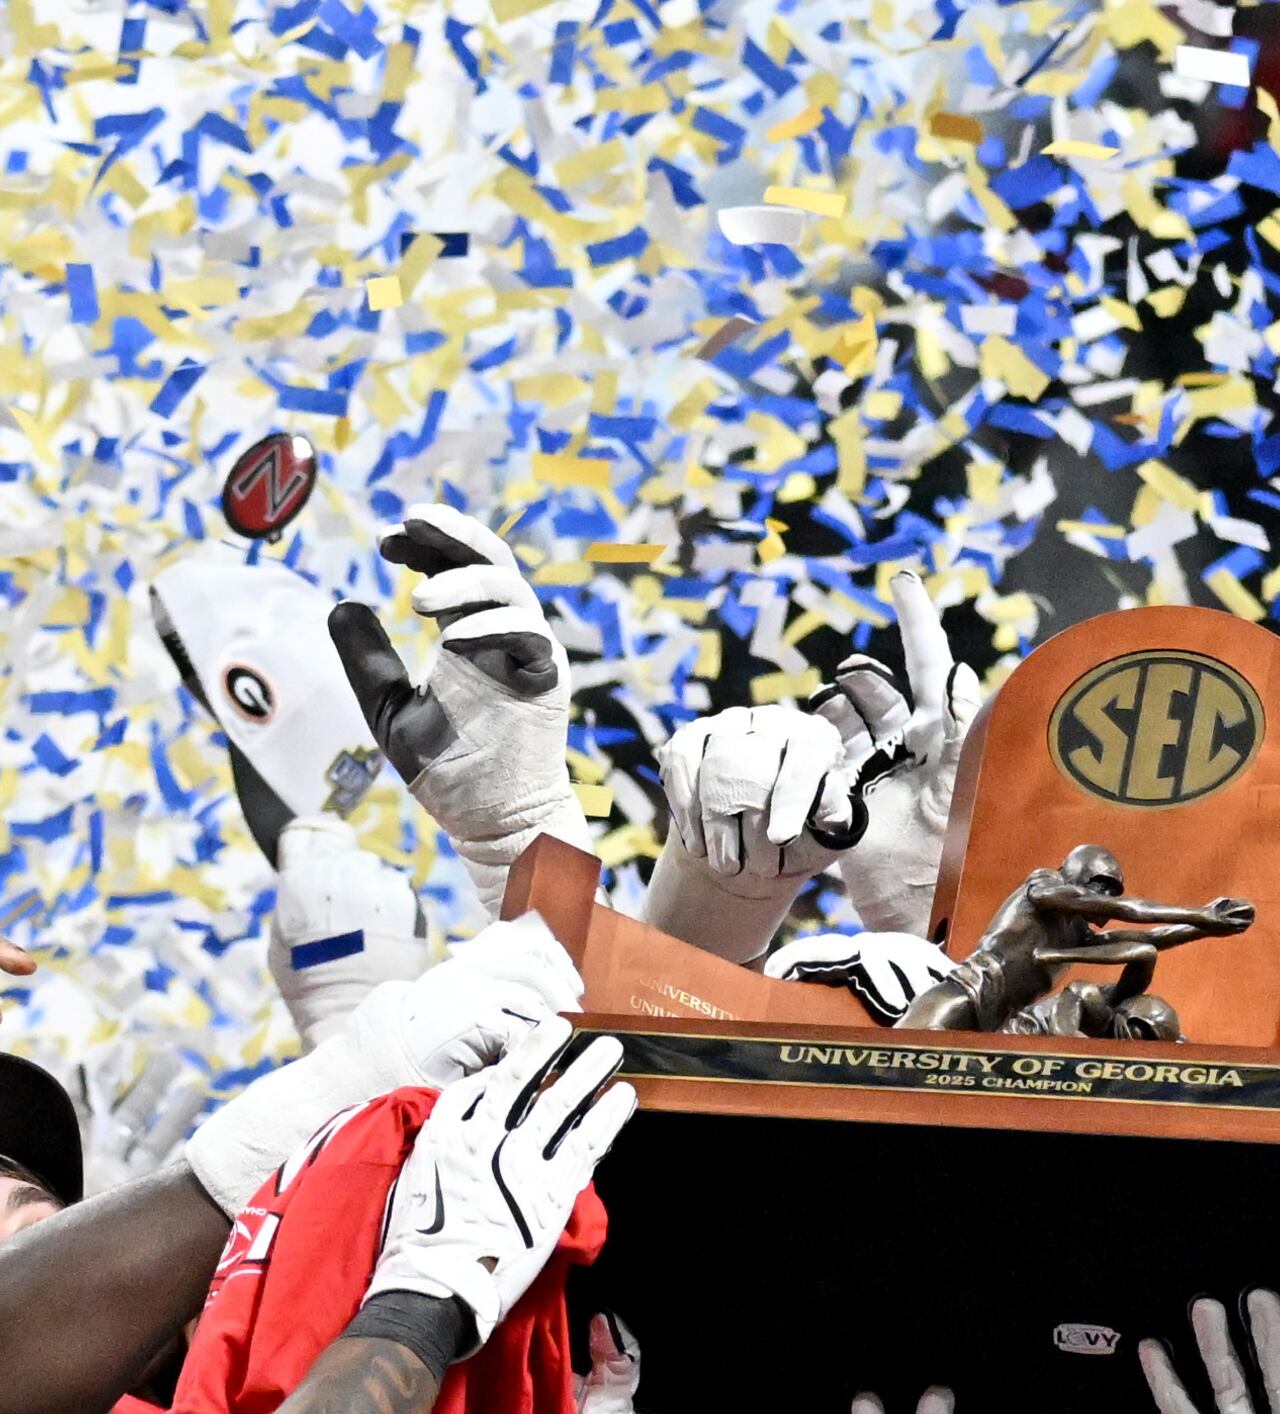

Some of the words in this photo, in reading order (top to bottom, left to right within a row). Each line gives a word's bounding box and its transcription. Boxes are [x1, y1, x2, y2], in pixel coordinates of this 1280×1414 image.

[226, 667, 276, 719] G
[1068, 662, 1247, 799] SEC
[779, 1045, 1004, 1073] UNIVERSITY
[1012, 1057, 1065, 1077] OF
[1074, 1061, 1245, 1087] GEORGIA
[924, 1073, 977, 1087] 2025
[982, 1076, 1093, 1094] CHAMPION
